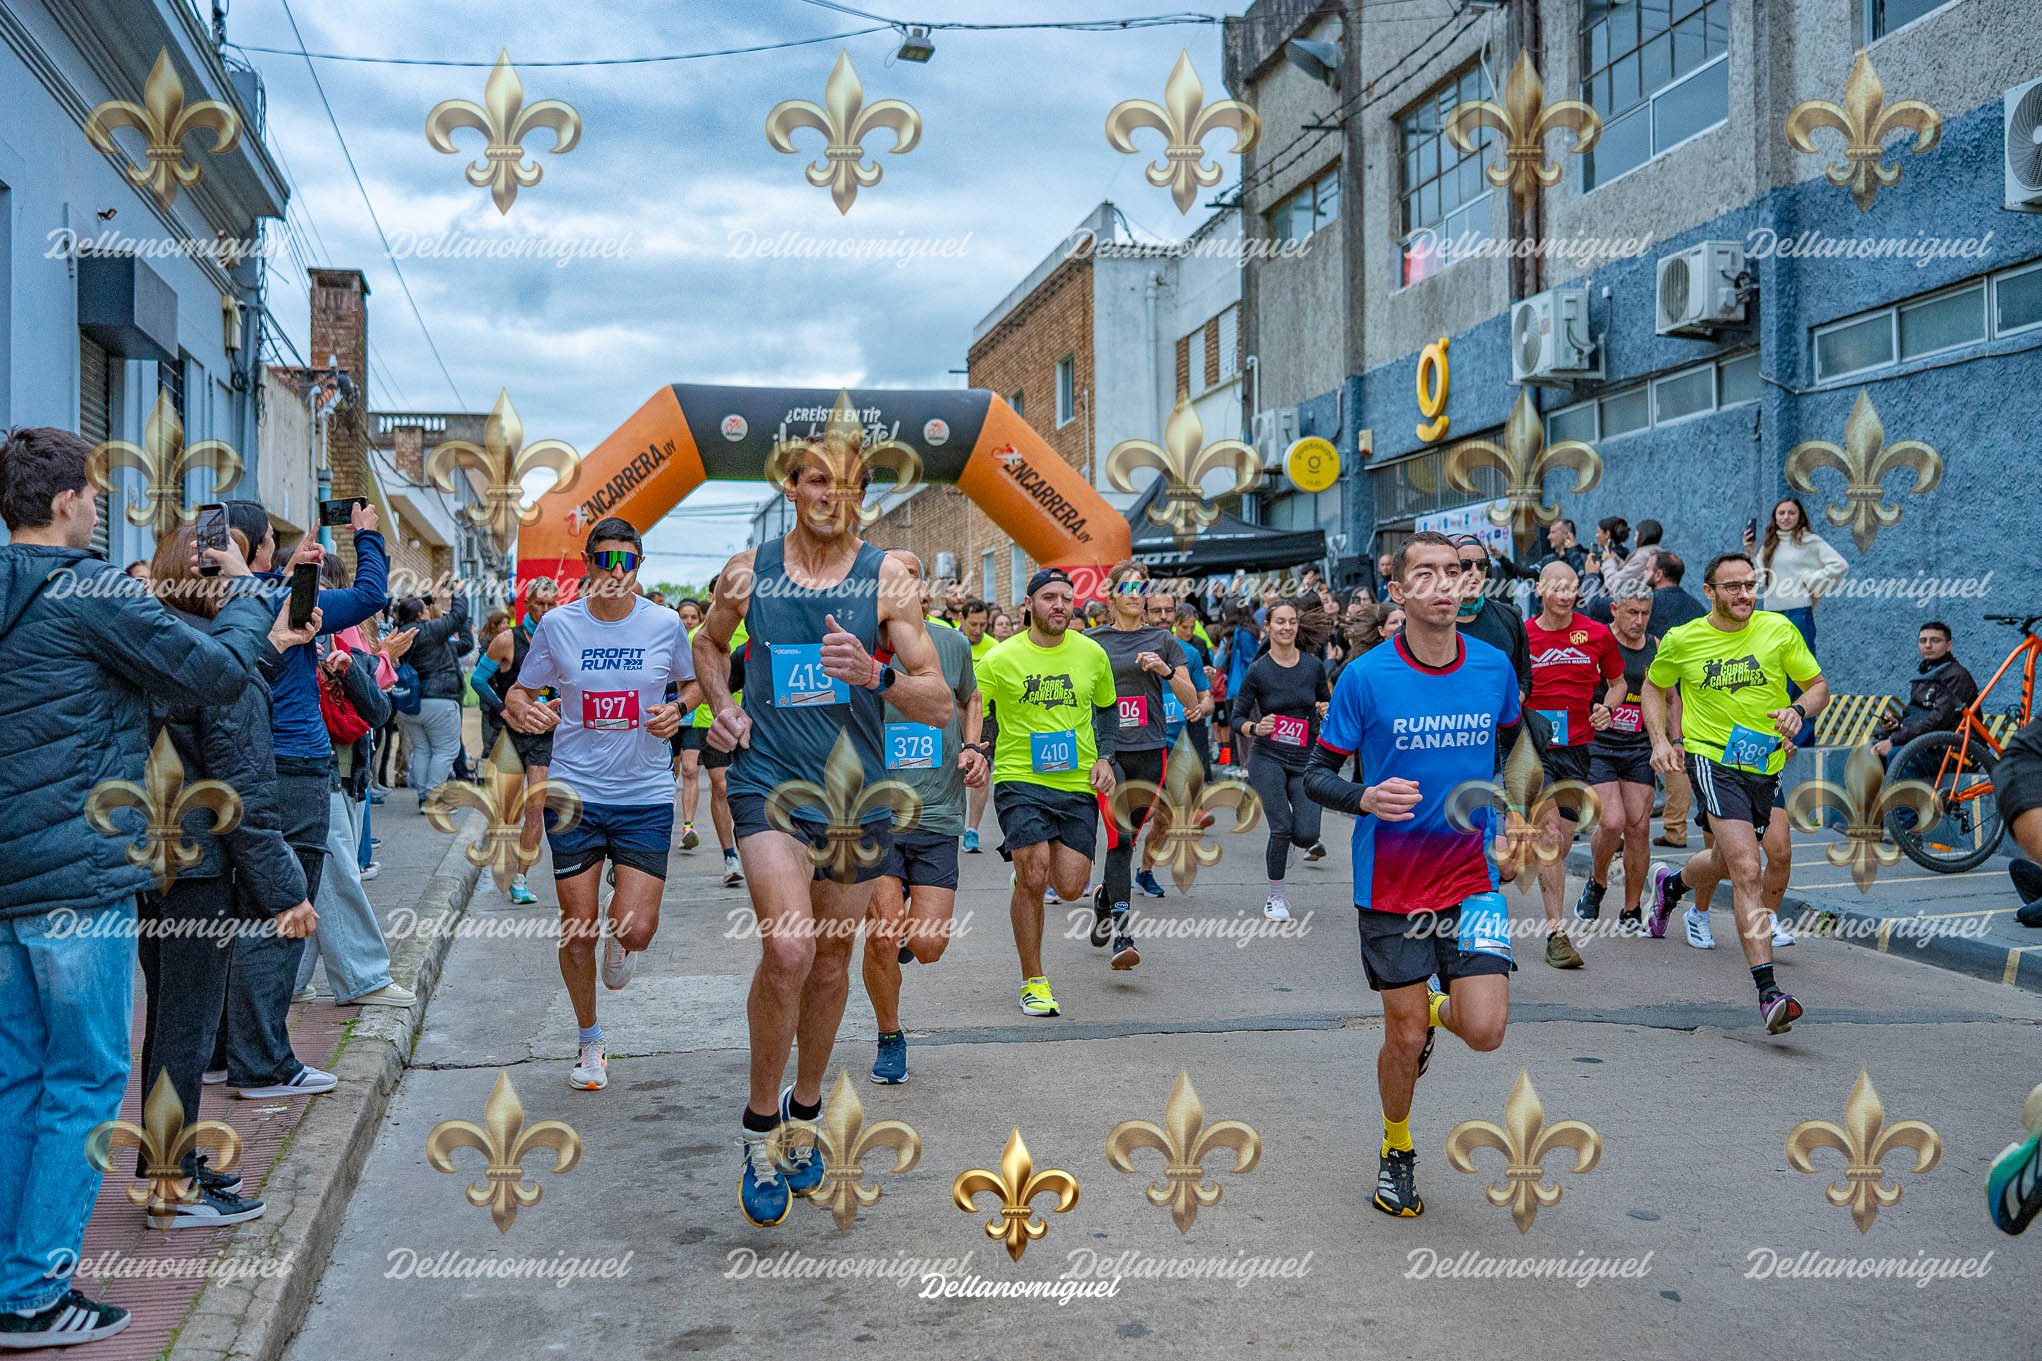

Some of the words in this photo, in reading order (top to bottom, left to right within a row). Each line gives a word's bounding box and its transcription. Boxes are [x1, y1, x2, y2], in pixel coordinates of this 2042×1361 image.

[844, 408, 860, 423] EN
[581, 648, 646, 660] PROFIT
[581, 659, 621, 671] RUN
[788, 663, 833, 690] 413
[593, 697, 626, 719] 197
[1120, 701, 1140, 717] 06
[1614, 707, 1640, 724] 225
[1278, 720, 1304, 737] 247
[1393, 713, 1491, 734] RUNNING
[894, 736, 934, 757] 378
[1395, 731, 1490, 750] CANARIO
[1041, 743, 1069, 761] 410
[1733, 740, 1767, 761] 389
